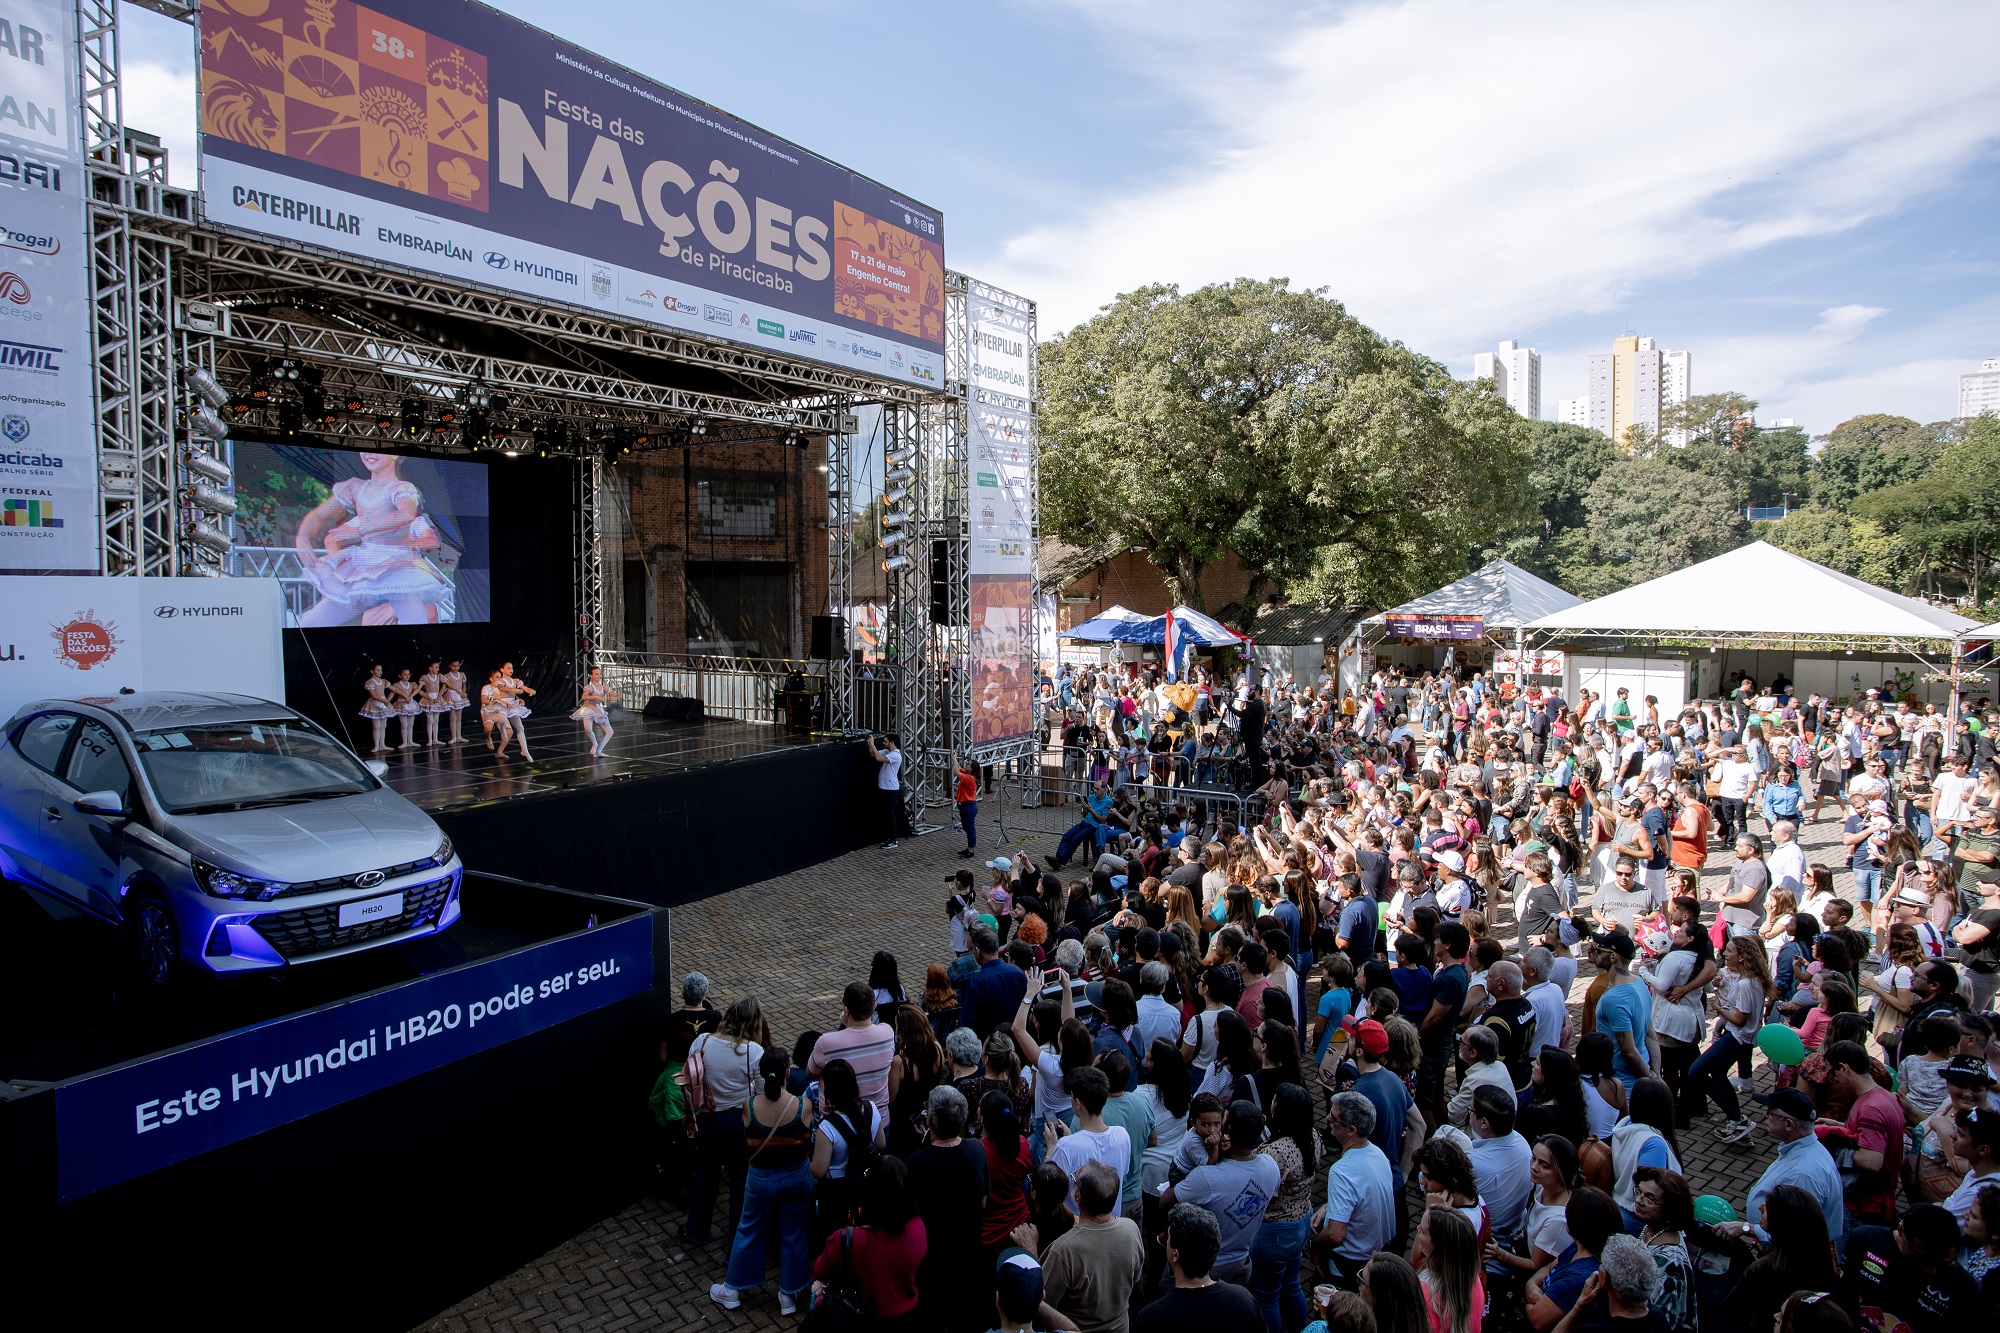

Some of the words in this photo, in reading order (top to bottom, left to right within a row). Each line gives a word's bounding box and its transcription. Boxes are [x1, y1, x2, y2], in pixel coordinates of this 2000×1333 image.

[555, 52, 593, 75] Ministério
[593, 70, 604, 79] da
[604, 74, 632, 93] Cultura,
[632, 86, 665, 106] Prefeitura
[666, 101, 675, 110] do
[705, 119, 715, 128] de
[714, 122, 744, 141] Piracicaba
[544, 89, 603, 130] Festa
[609, 118, 645, 146] das
[498, 97, 831, 281] NAÇÕES
[233, 185, 361, 236] CATERPILLAR
[378, 227, 473, 263] EMBRAPLAN
[680, 246, 704, 267] de
[709, 253, 794, 294] Piracicaba
[850, 249, 859, 261] 17
[860, 255, 866, 263] a
[867, 254, 875, 266] 21
[876, 260, 886, 270] de
[887, 265, 906, 278] maio
[514, 259, 578, 286] HYUNDAI
[846, 264, 882, 285] Engenho
[883, 278, 910, 294] Central
[677, 301, 697, 312] Drogal
[759, 321, 778, 331] Unimed
[789, 330, 817, 344] UNIMIL
[972, 329, 1023, 358] CATERPILLAR
[859, 346, 882, 358] Piracicaba
[973, 363, 1025, 388] EMBRAPLAN
[990, 393, 1026, 410] HYUNDAI
[29, 468, 54, 476] SÉRIO
[2, 487, 53, 497] FEDERAL
[182, 606, 243, 617] HYUNDAI
[67, 631, 96, 639] FESTA
[1414, 624, 1451, 634] BRASIL
[67, 638, 87, 646] DAS
[67, 644, 107, 655] NAÇÕES
[361, 904, 383, 915] HB20
[136, 1081, 221, 1135] Este
[231, 1029, 378, 1103] Hyundai
[385, 1004, 463, 1051] HB20
[469, 983, 535, 1026] pode
[539, 970, 575, 999] ser
[577, 955, 621, 986] seu.
[1866, 1251, 1889, 1268] TOTAL
[1860, 1269, 1881, 1284] GEOX
